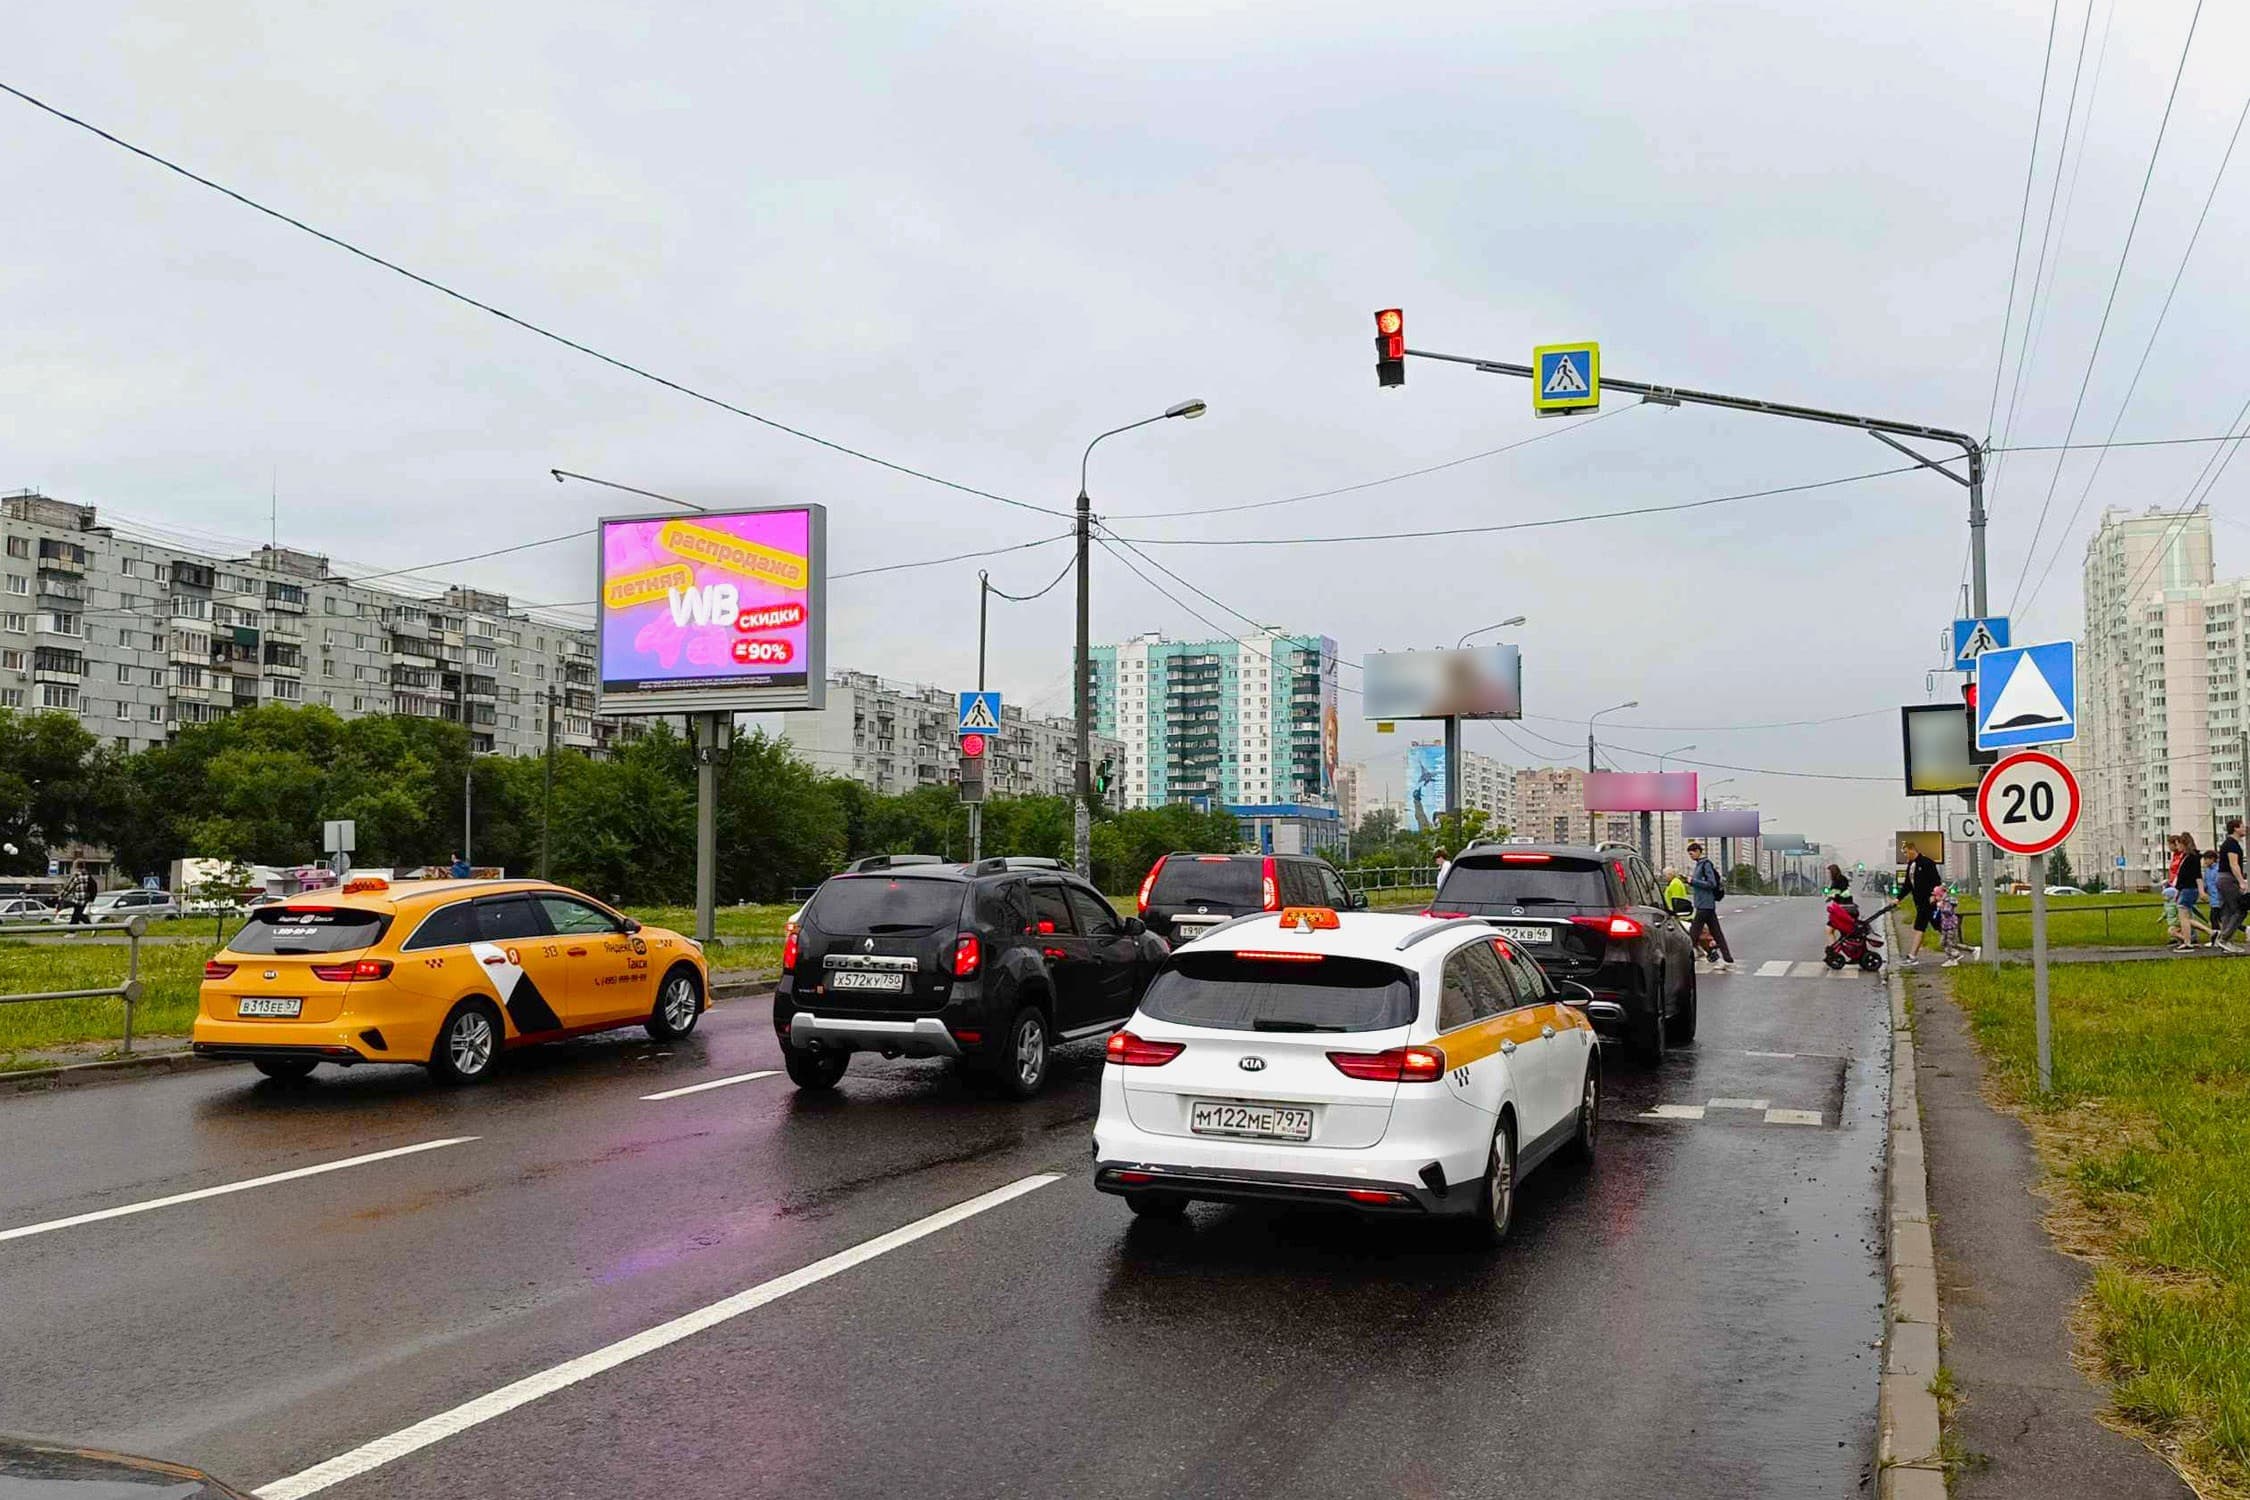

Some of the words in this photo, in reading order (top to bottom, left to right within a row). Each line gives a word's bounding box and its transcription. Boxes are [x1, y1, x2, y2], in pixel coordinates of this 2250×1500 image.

[669, 530, 801, 580] распродажа
[610, 570, 686, 600] летняя
[668, 583, 740, 628] WB
[738, 608, 800, 628] скидки
[2002, 781, 2054, 824] 20
[825, 960, 912, 970] DUSTER
[883, 975, 900, 985] 750
[286, 1000, 297, 1009] 57
[1241, 1059, 1262, 1069] KIA
[1276, 1111, 1304, 1127] 797
